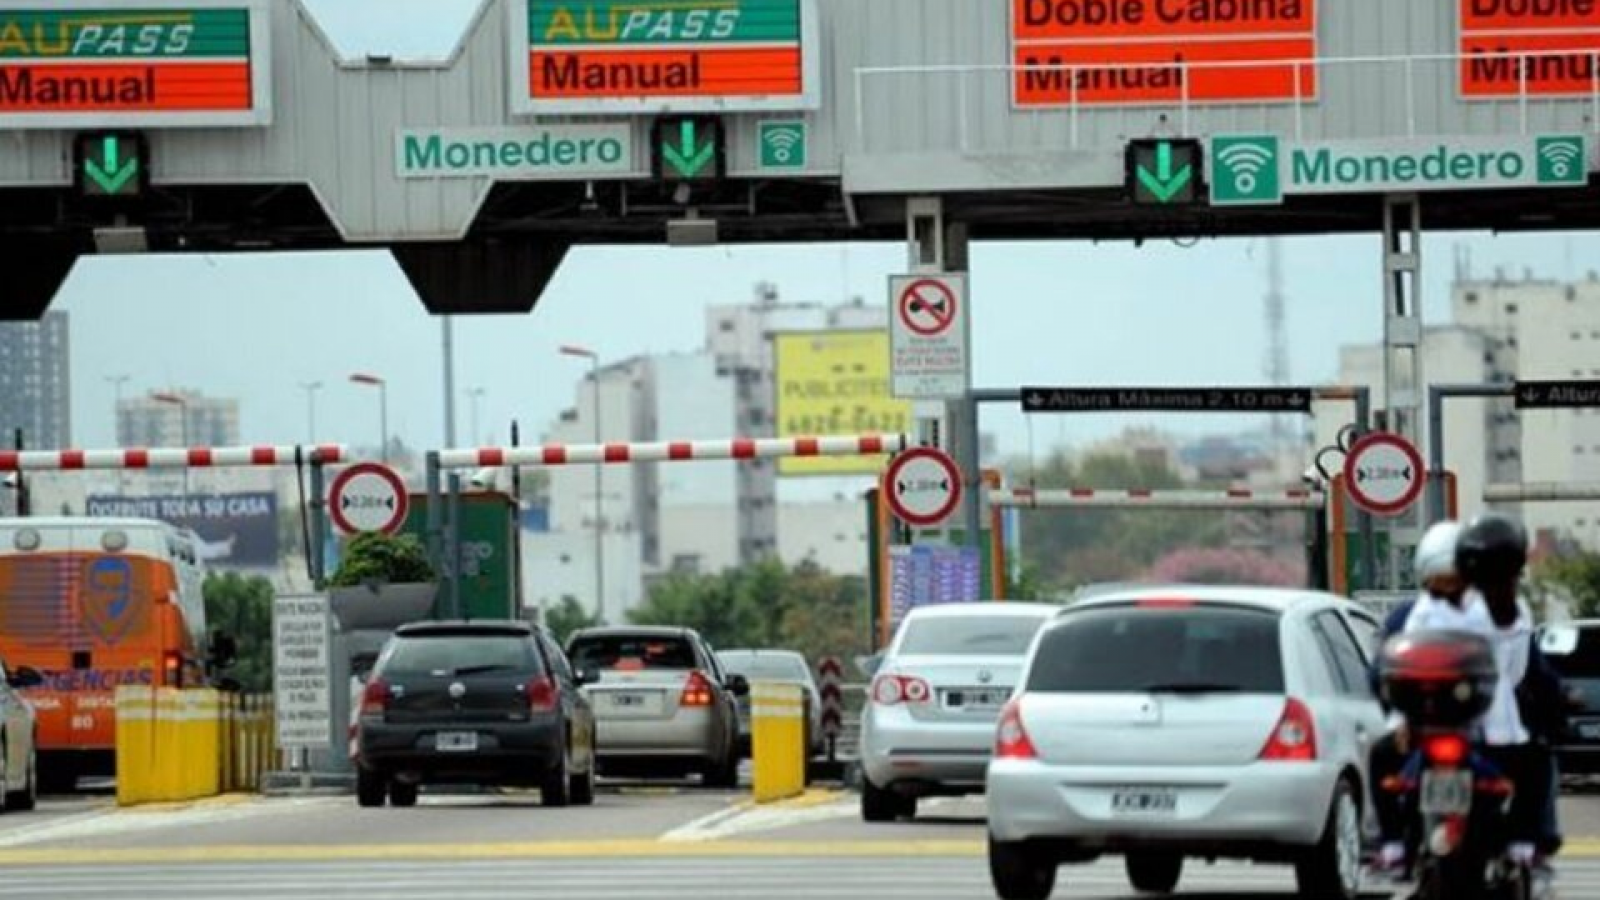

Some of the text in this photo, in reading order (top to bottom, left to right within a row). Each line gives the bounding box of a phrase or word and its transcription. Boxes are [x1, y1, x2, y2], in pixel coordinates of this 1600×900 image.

[1023, 0, 1302, 26] Doble Cabina
[0, 66, 156, 105] Manual
[541, 52, 699, 91] Manual
[404, 131, 622, 170] Monedero
[1291, 145, 1524, 185] Monedero
[1050, 391, 1111, 406] Altura
[227, 495, 270, 515] CASA
